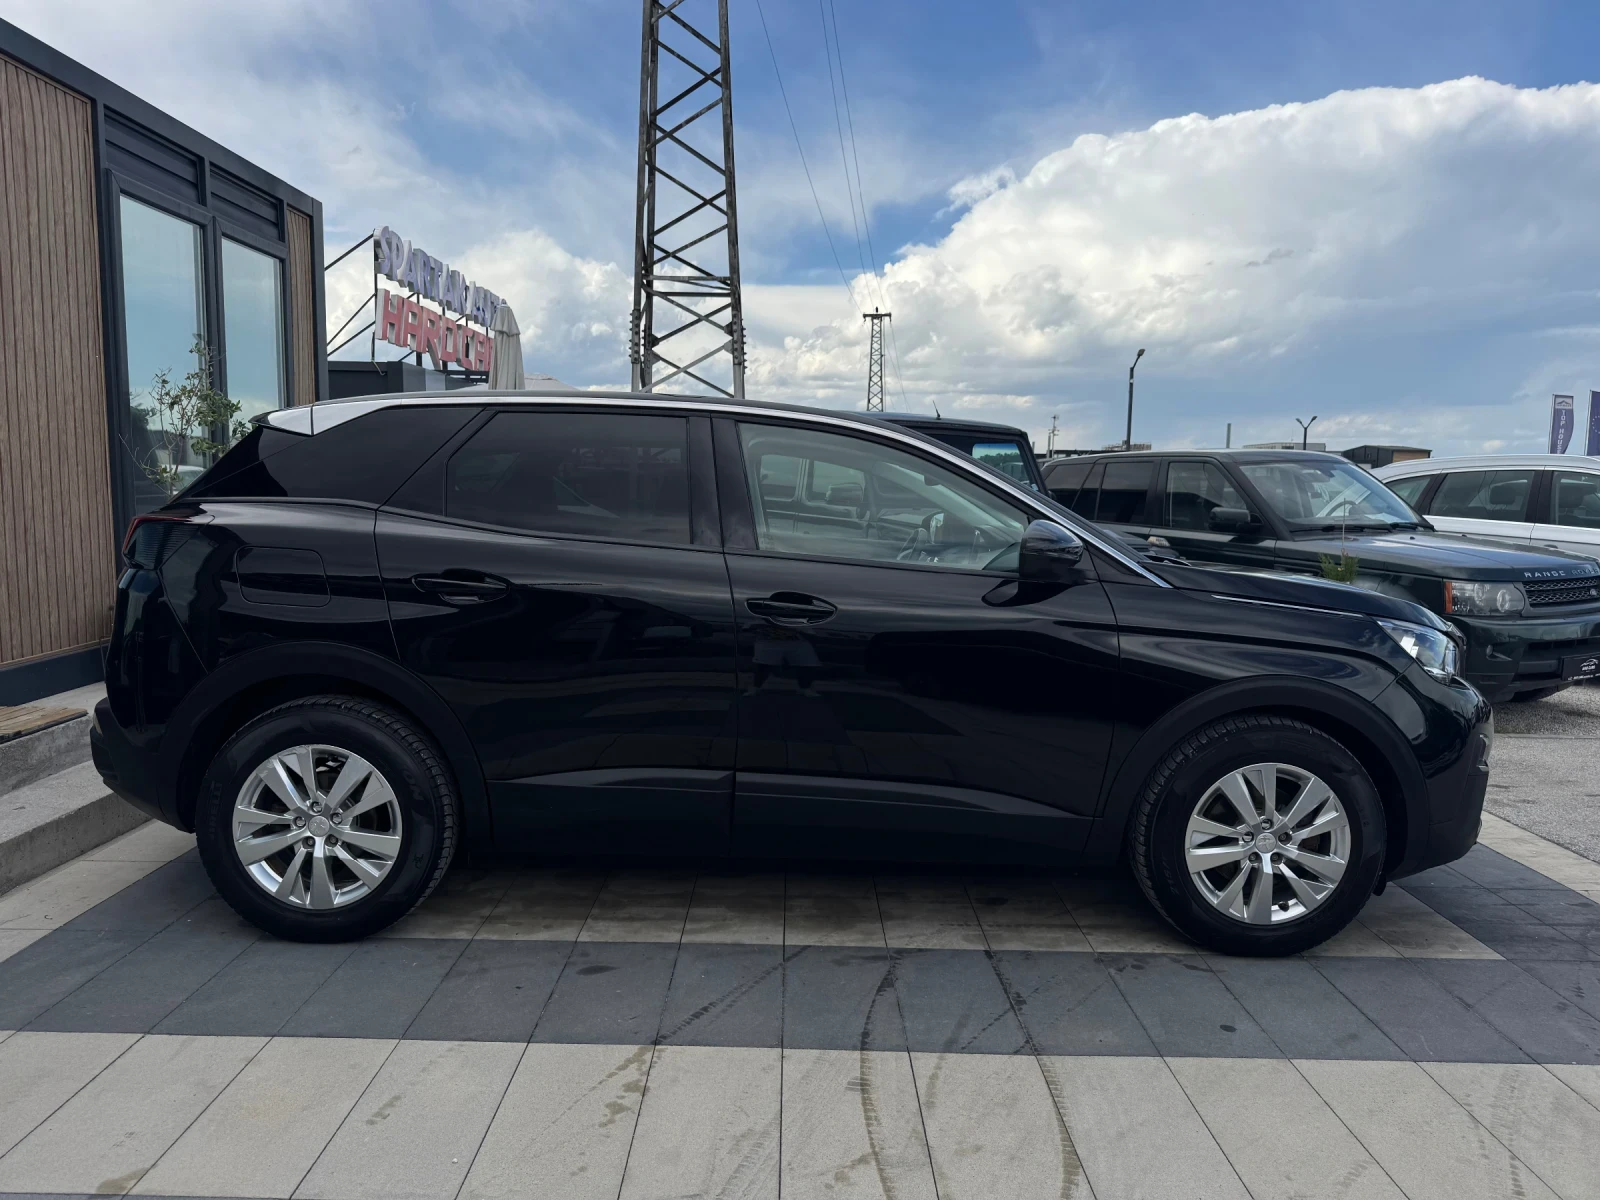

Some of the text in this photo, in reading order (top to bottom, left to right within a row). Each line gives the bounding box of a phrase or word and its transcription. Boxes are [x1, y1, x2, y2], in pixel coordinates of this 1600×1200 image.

[373, 226, 467, 316] SPARTAK
[375, 288, 457, 370] HARD
[1523, 570, 1566, 578] RANGE
